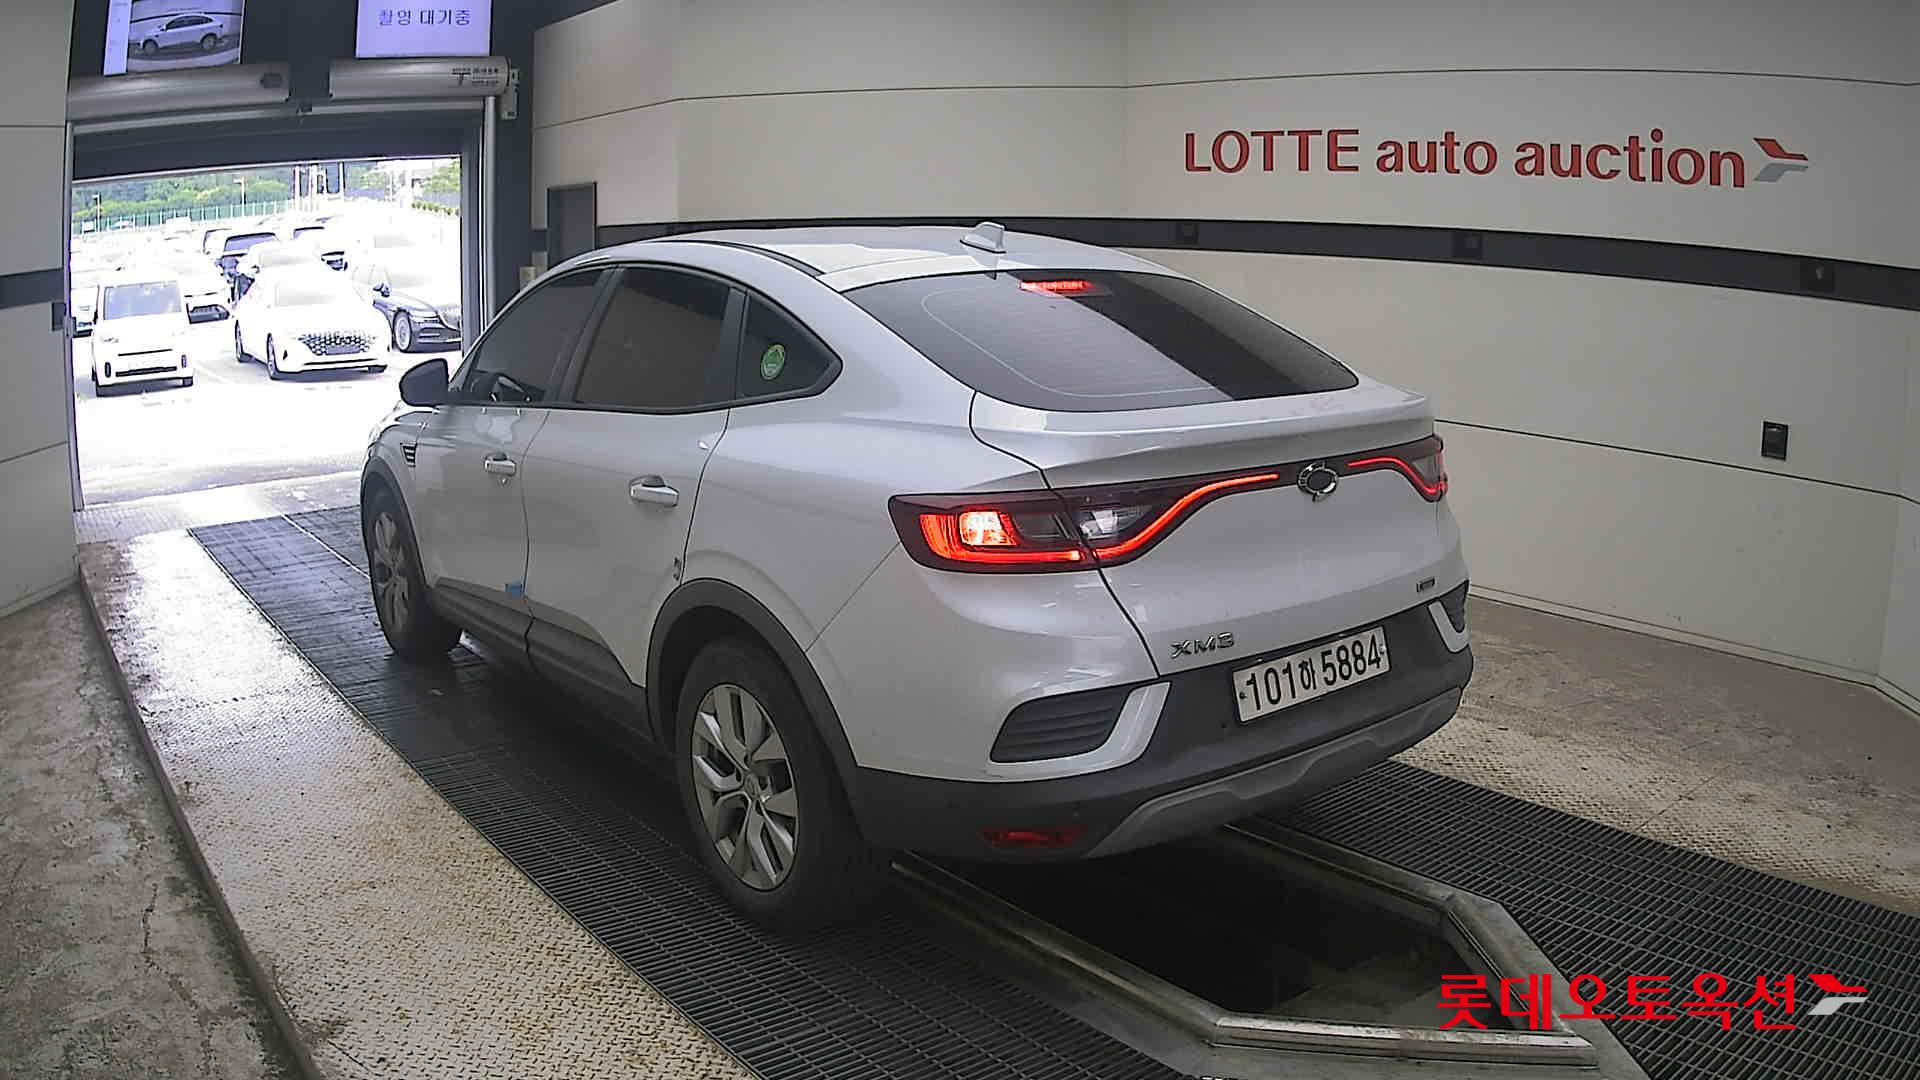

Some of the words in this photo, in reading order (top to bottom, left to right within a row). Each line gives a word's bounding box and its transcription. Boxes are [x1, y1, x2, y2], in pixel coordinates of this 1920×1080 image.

[420, 9, 470, 25] 대기중
[1184, 130, 1360, 173] LOTTE
[1376, 131, 1498, 176] auto
[1514, 129, 1745, 188] auction
[1170, 632, 1235, 658] XM3
